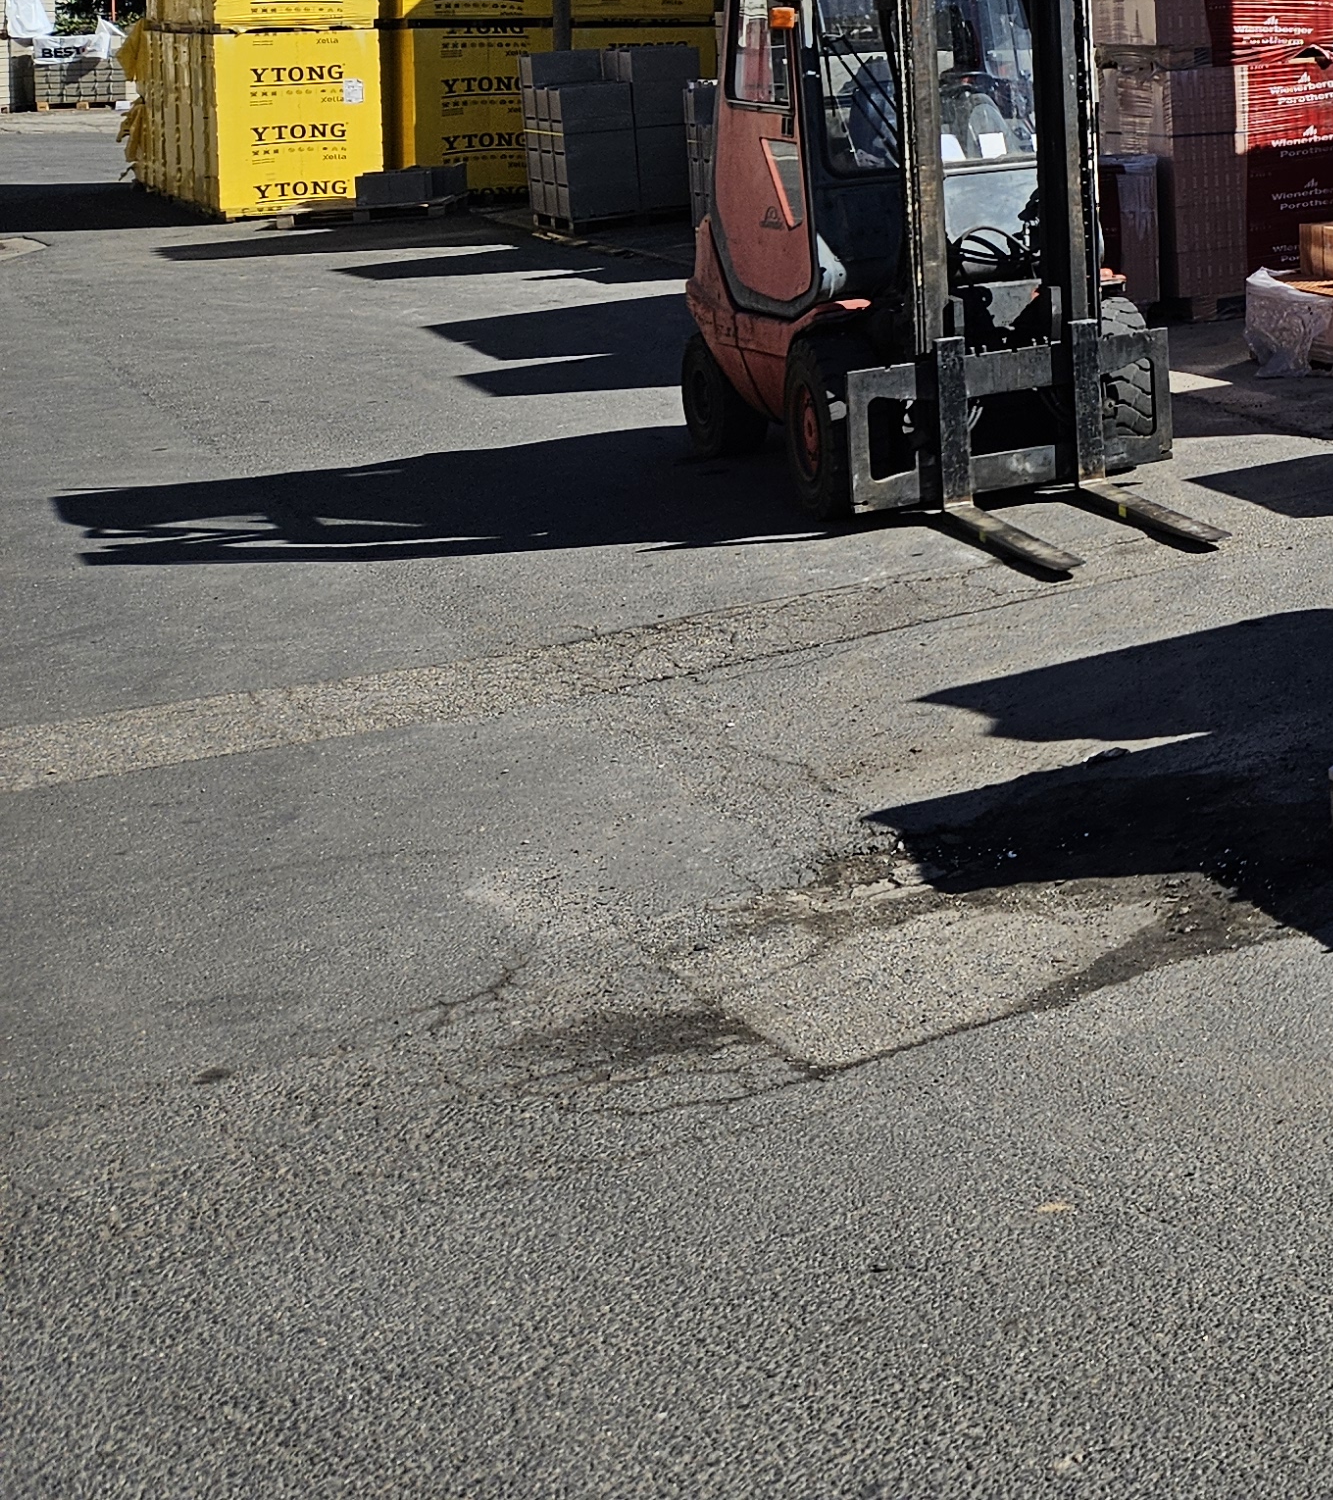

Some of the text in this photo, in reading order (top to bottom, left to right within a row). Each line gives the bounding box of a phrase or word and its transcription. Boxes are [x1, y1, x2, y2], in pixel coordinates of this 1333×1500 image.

[41, 47, 78, 58] BEST
[250, 65, 344, 82] YTONG
[251, 123, 346, 141] YTONG
[254, 180, 348, 198] YTONG
